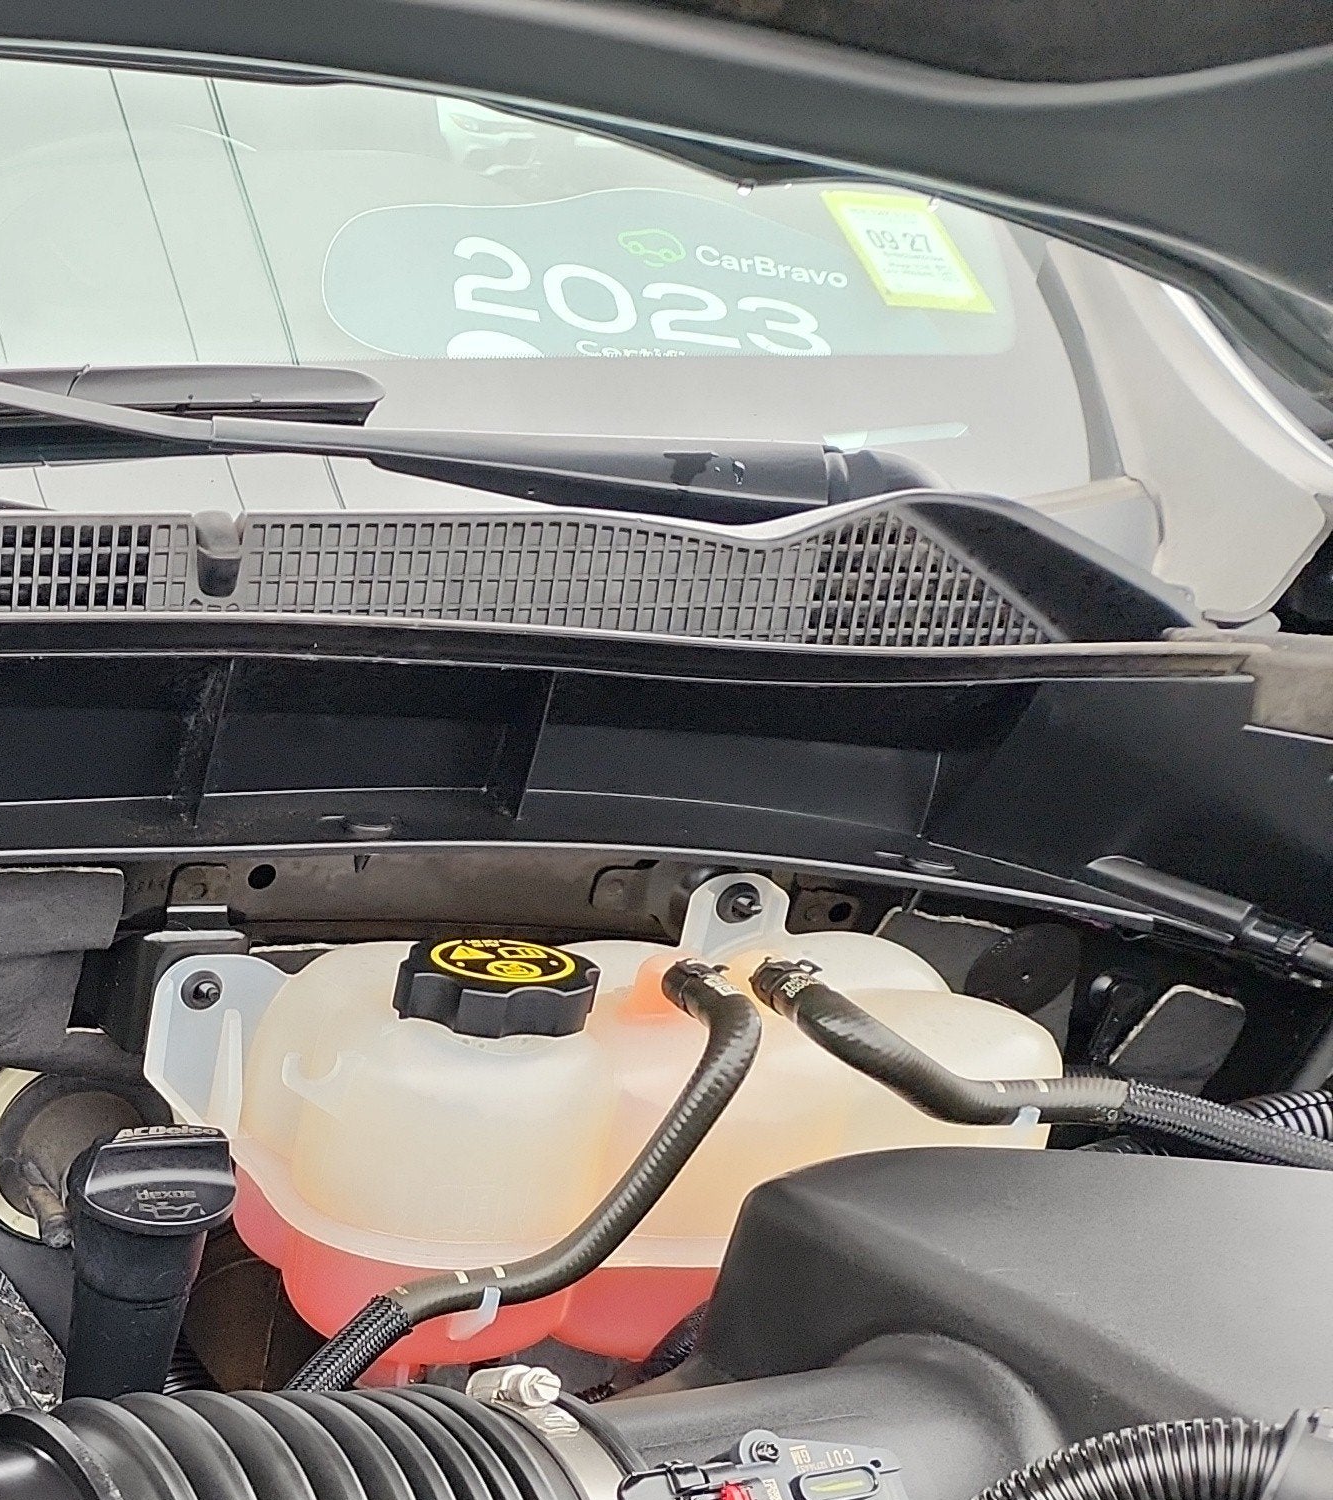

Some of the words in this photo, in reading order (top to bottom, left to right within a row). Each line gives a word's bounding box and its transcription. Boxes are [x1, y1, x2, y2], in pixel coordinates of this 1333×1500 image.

[866, 229, 899, 250] 09
[695, 245, 848, 288] CarBravo
[453, 236, 832, 356] 2023
[114, 1126, 219, 1140] ACDelco
[789, 1445, 811, 1465] GM
